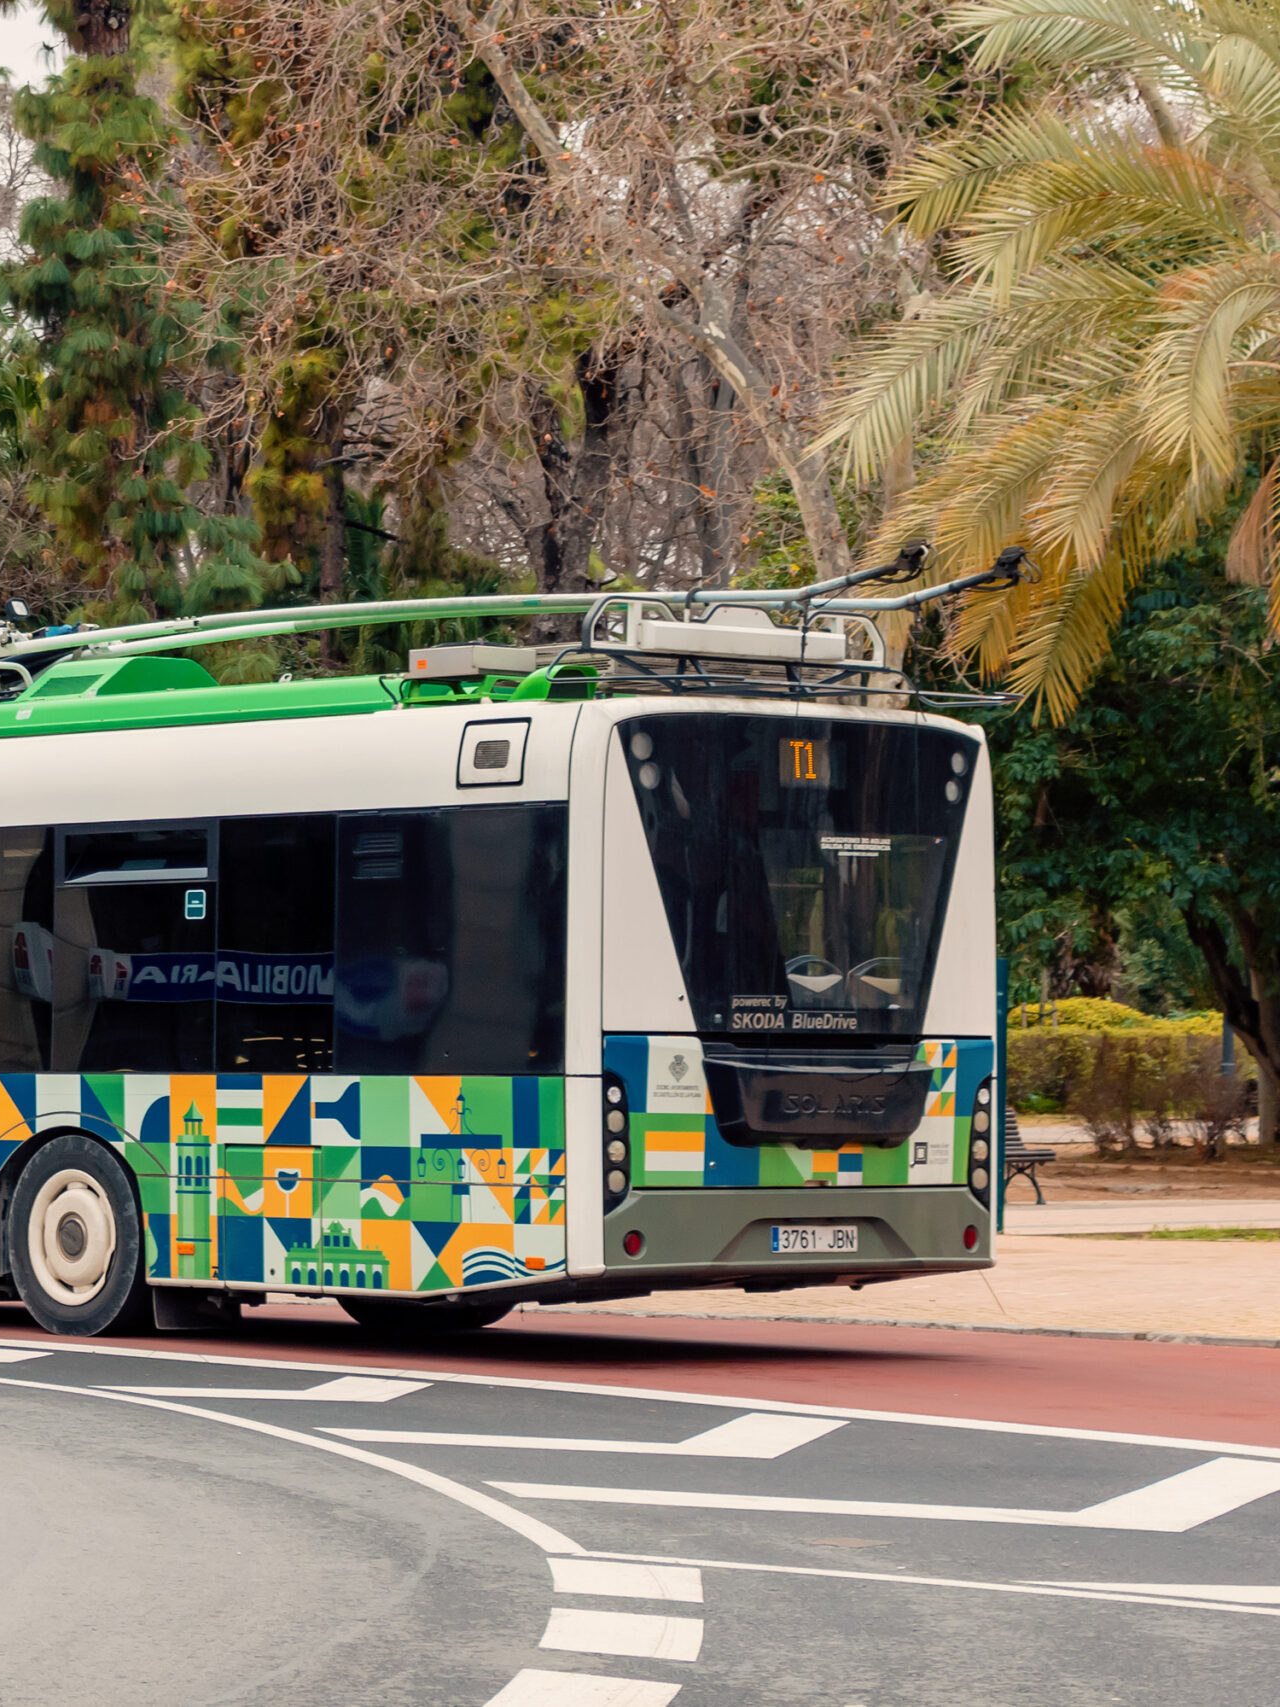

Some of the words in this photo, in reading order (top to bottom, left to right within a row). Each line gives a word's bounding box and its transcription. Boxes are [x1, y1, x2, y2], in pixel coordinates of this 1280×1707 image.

[789, 741, 817, 779] T1
[774, 996, 788, 1009] by
[732, 1013, 785, 1029] SKODA
[791, 1013, 857, 1030] BlueDrive
[783, 1094, 887, 1114] SOLARIS
[782, 1229, 816, 1249] 3761
[827, 1229, 855, 1249] JBN
